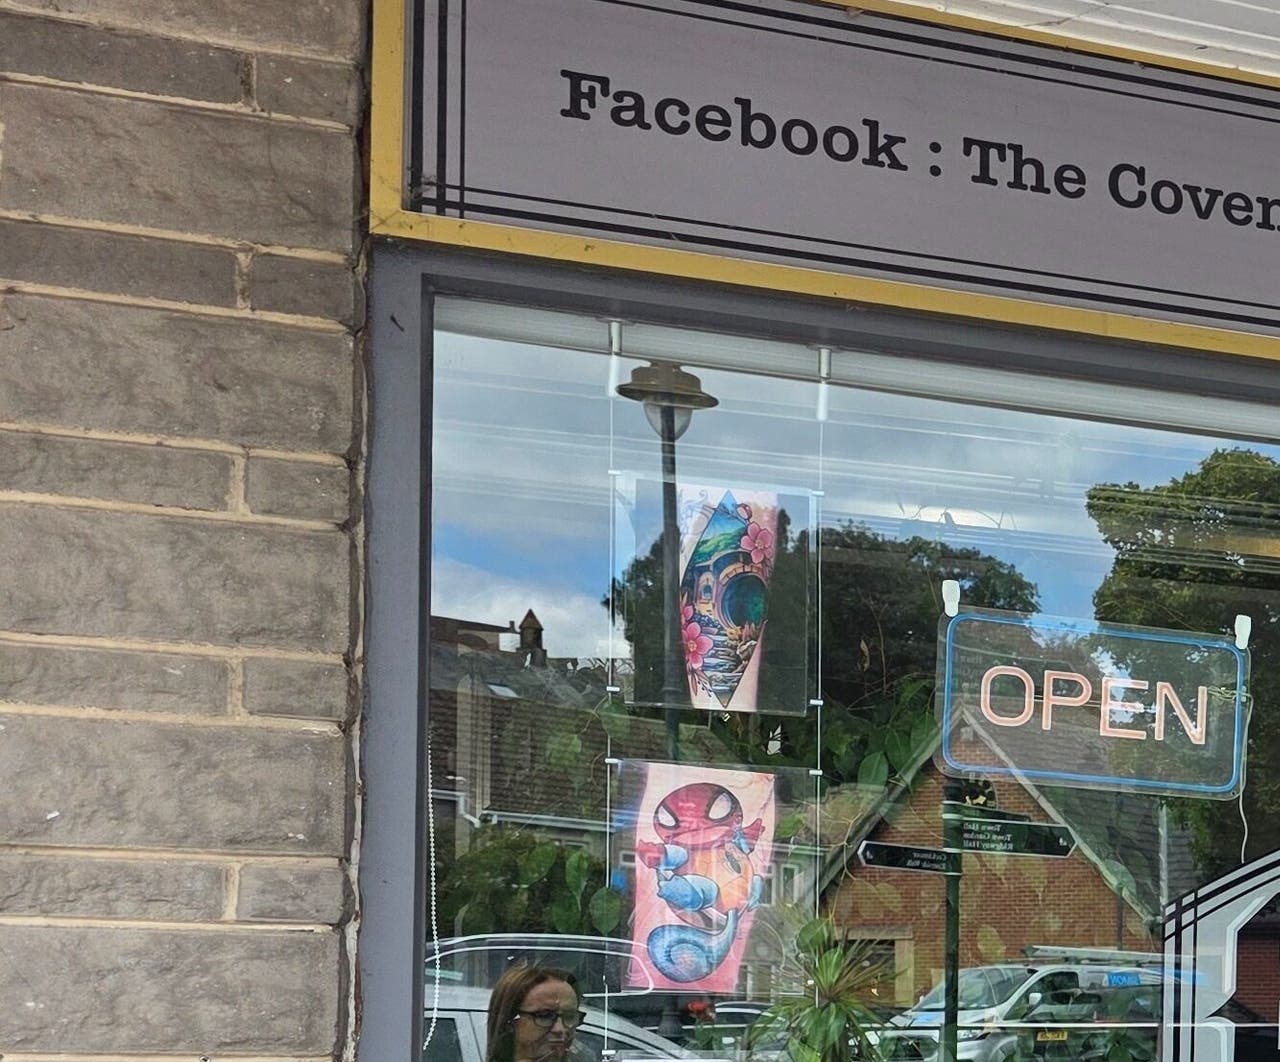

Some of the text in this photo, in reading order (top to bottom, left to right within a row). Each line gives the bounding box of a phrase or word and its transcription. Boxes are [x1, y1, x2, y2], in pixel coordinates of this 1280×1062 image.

[560, 69, 908, 172] Facebook
[962, 136, 1087, 200] The
[980, 664, 1208, 745] OPEN
